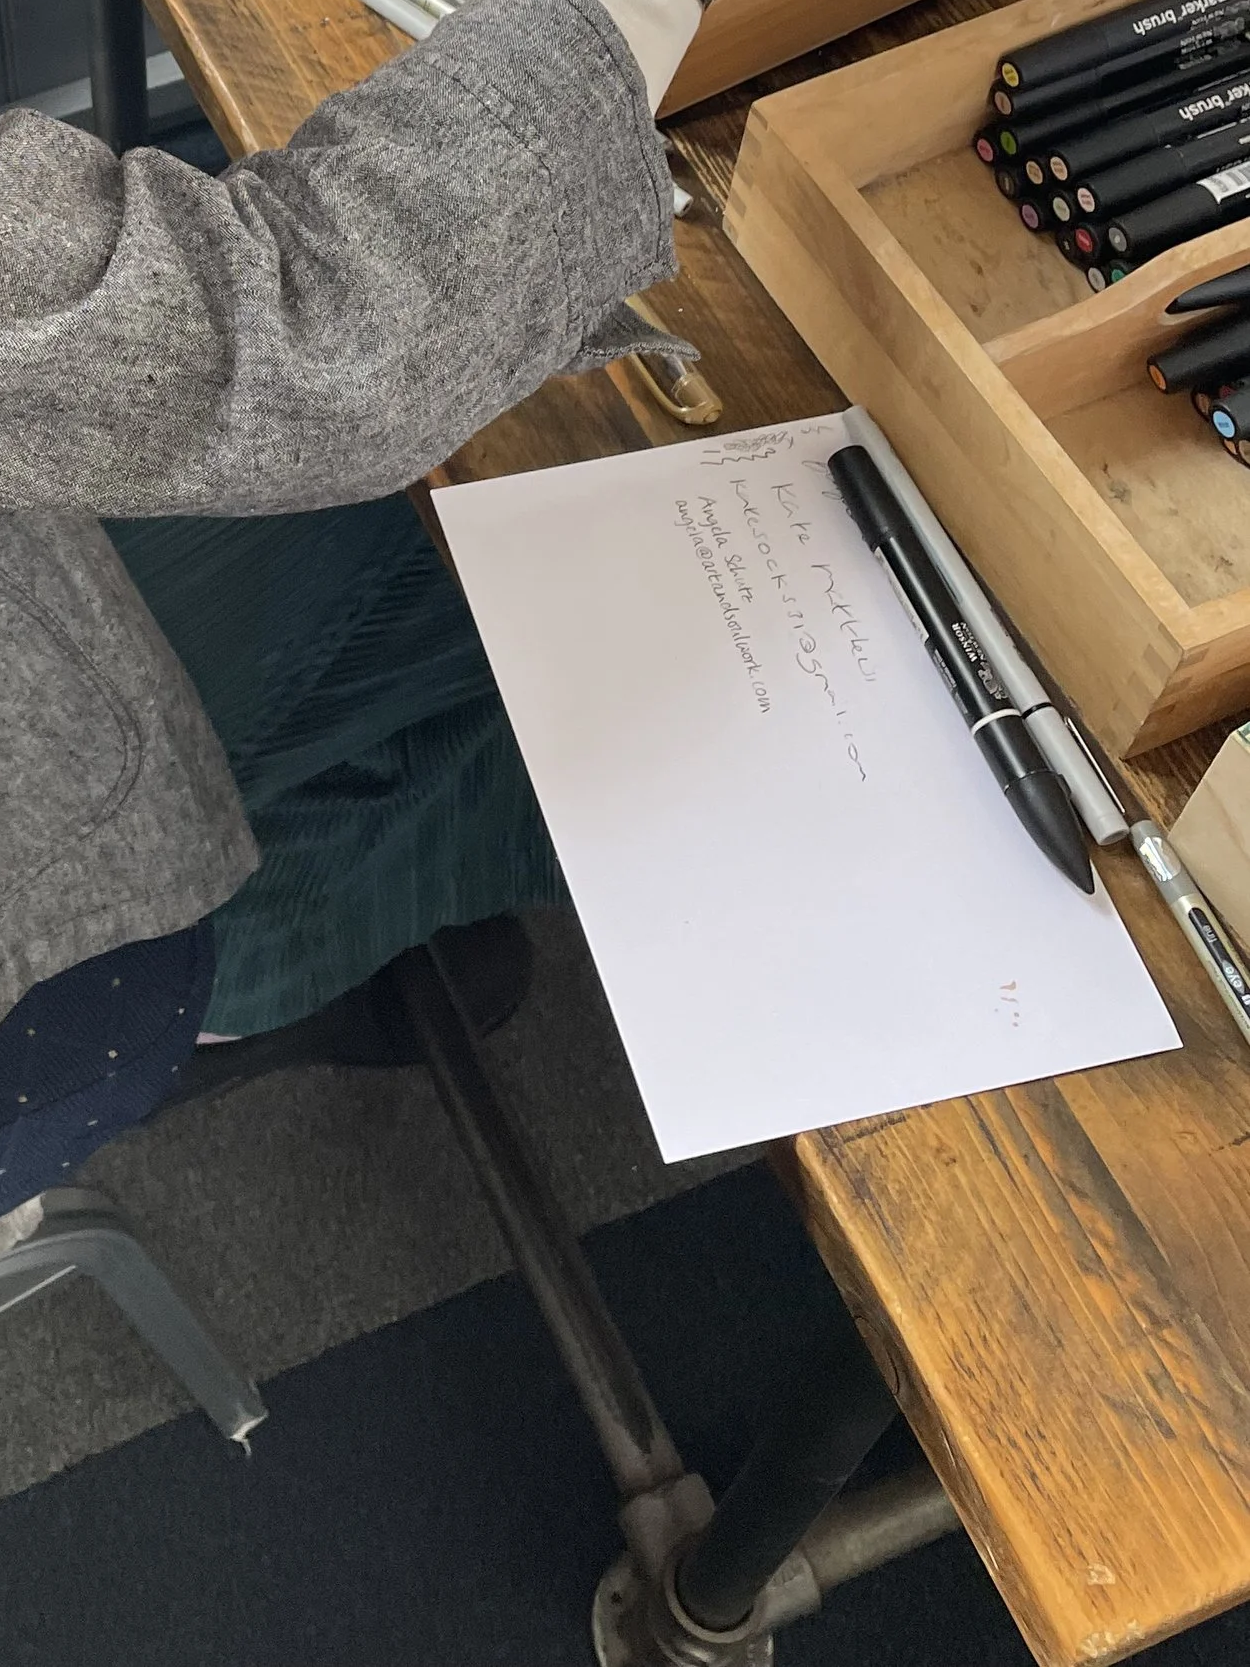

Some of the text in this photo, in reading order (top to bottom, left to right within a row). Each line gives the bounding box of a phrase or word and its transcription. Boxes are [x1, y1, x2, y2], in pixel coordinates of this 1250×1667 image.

[1132, 9, 1177, 36] brush
[1178, 94, 1225, 121] brush
[690, 495, 727, 550] Angela
[951, 622, 978, 662] WINSOR
[1224, 965, 1243, 989] eye
